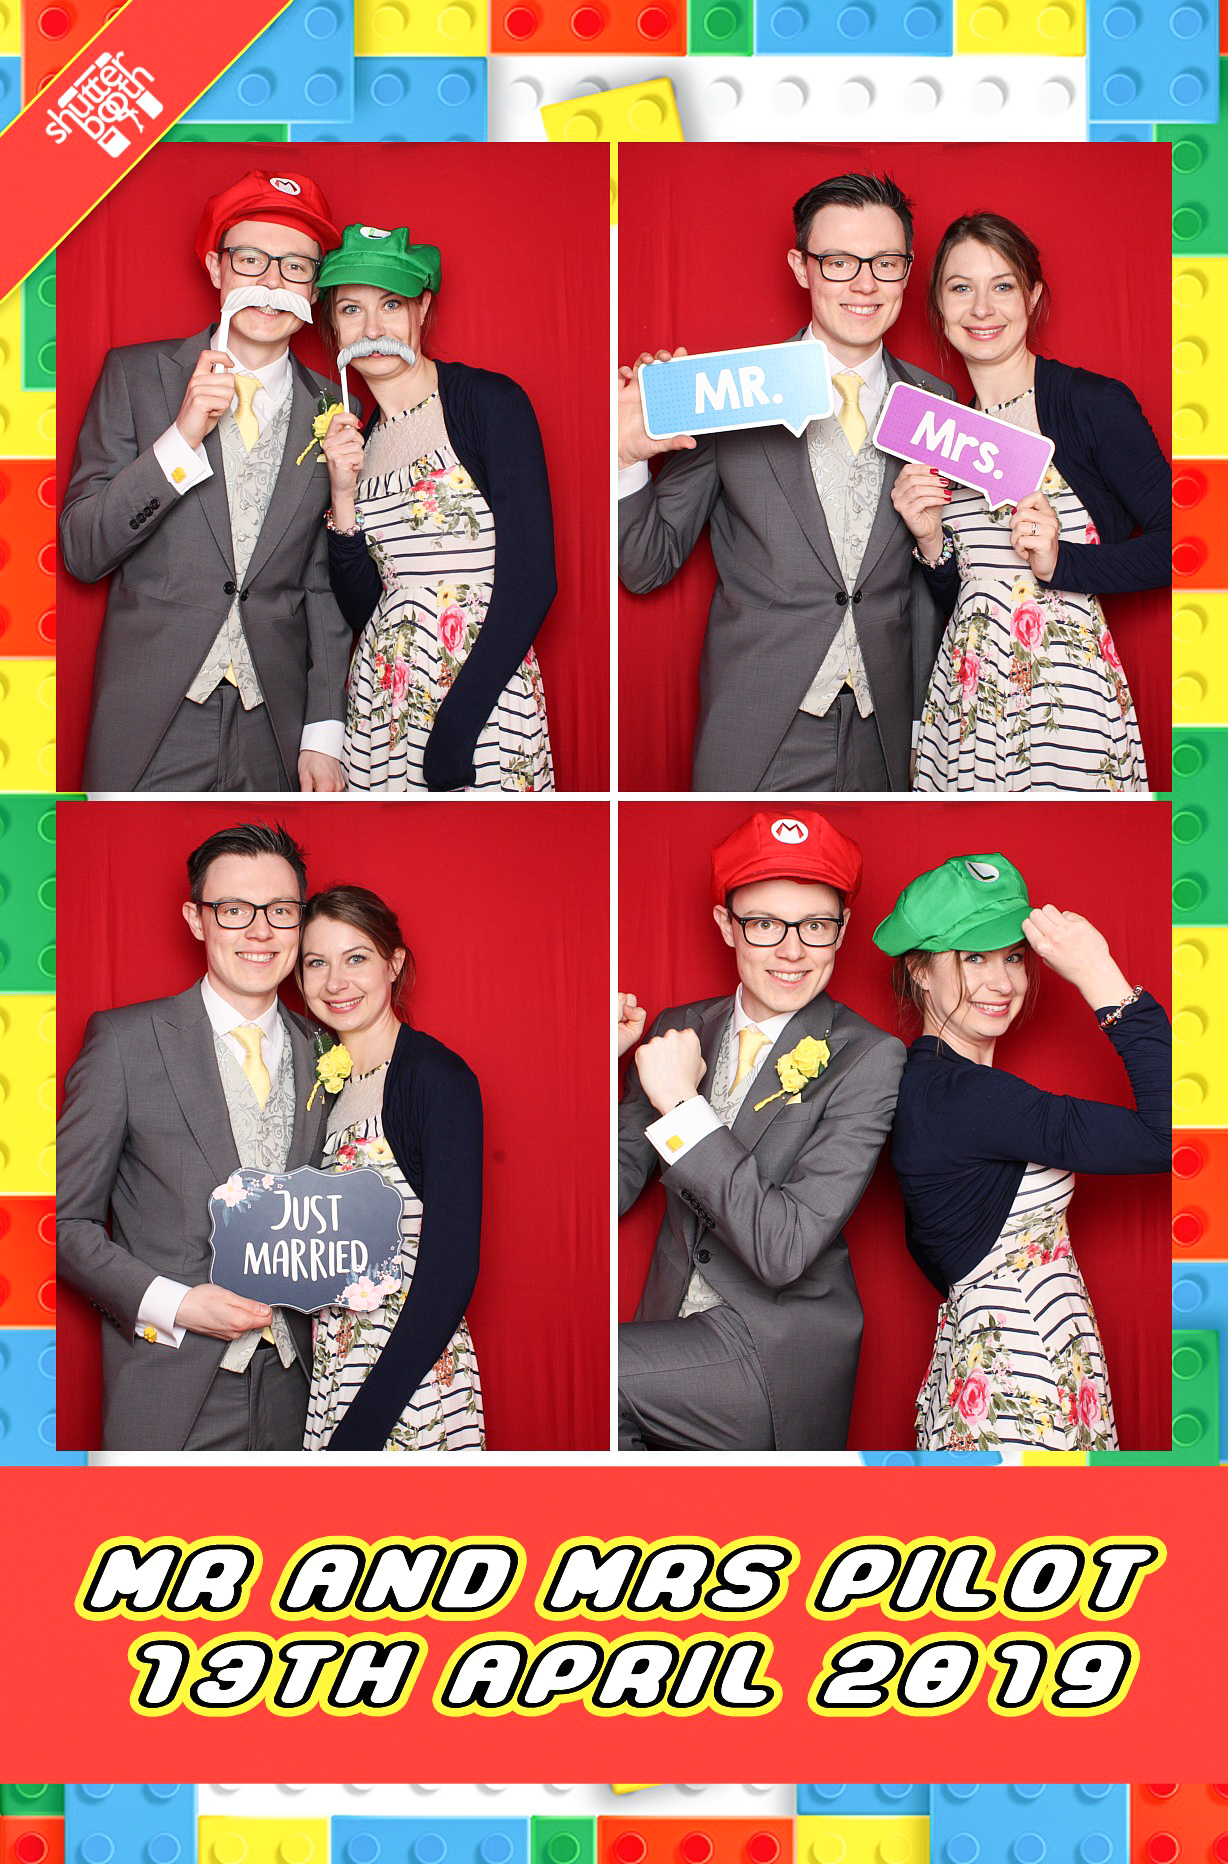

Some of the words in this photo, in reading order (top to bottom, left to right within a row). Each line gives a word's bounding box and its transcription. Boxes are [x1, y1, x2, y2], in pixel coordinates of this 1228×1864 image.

[695, 365, 783, 414] MR.
[910, 410, 1003, 480] Mrs.
[776, 822, 804, 839] M
[270, 1190, 343, 1234] JUST
[243, 1238, 369, 1281] MARRIED
